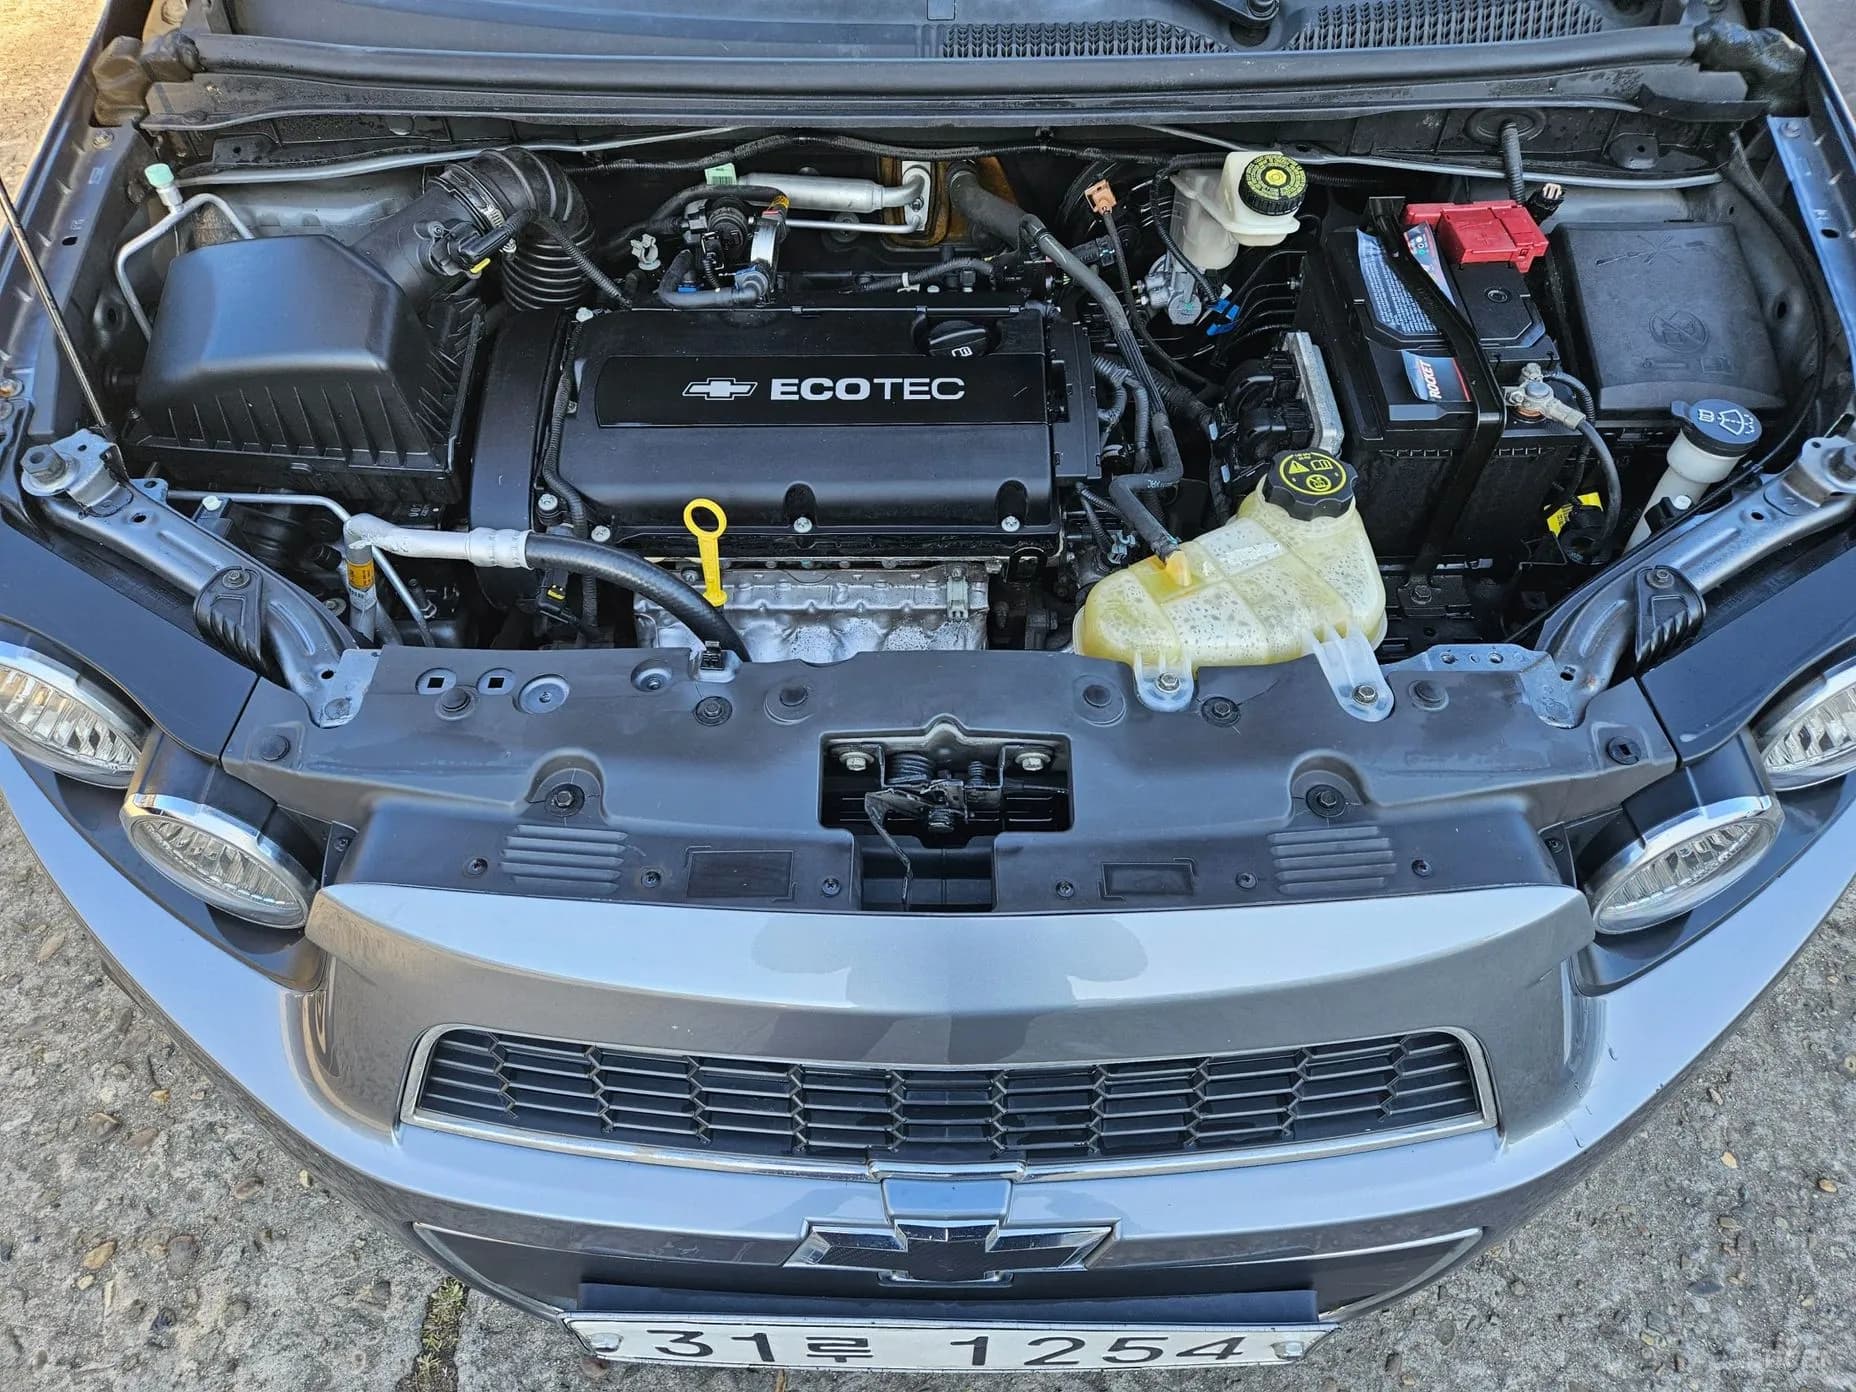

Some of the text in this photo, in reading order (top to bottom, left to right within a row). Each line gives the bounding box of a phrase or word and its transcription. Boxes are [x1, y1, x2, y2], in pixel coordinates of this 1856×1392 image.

[770, 377, 966, 401] ECOTEC
[1419, 359, 1443, 399] ROCKET
[646, 1329, 1248, 1366] 31루 1254
